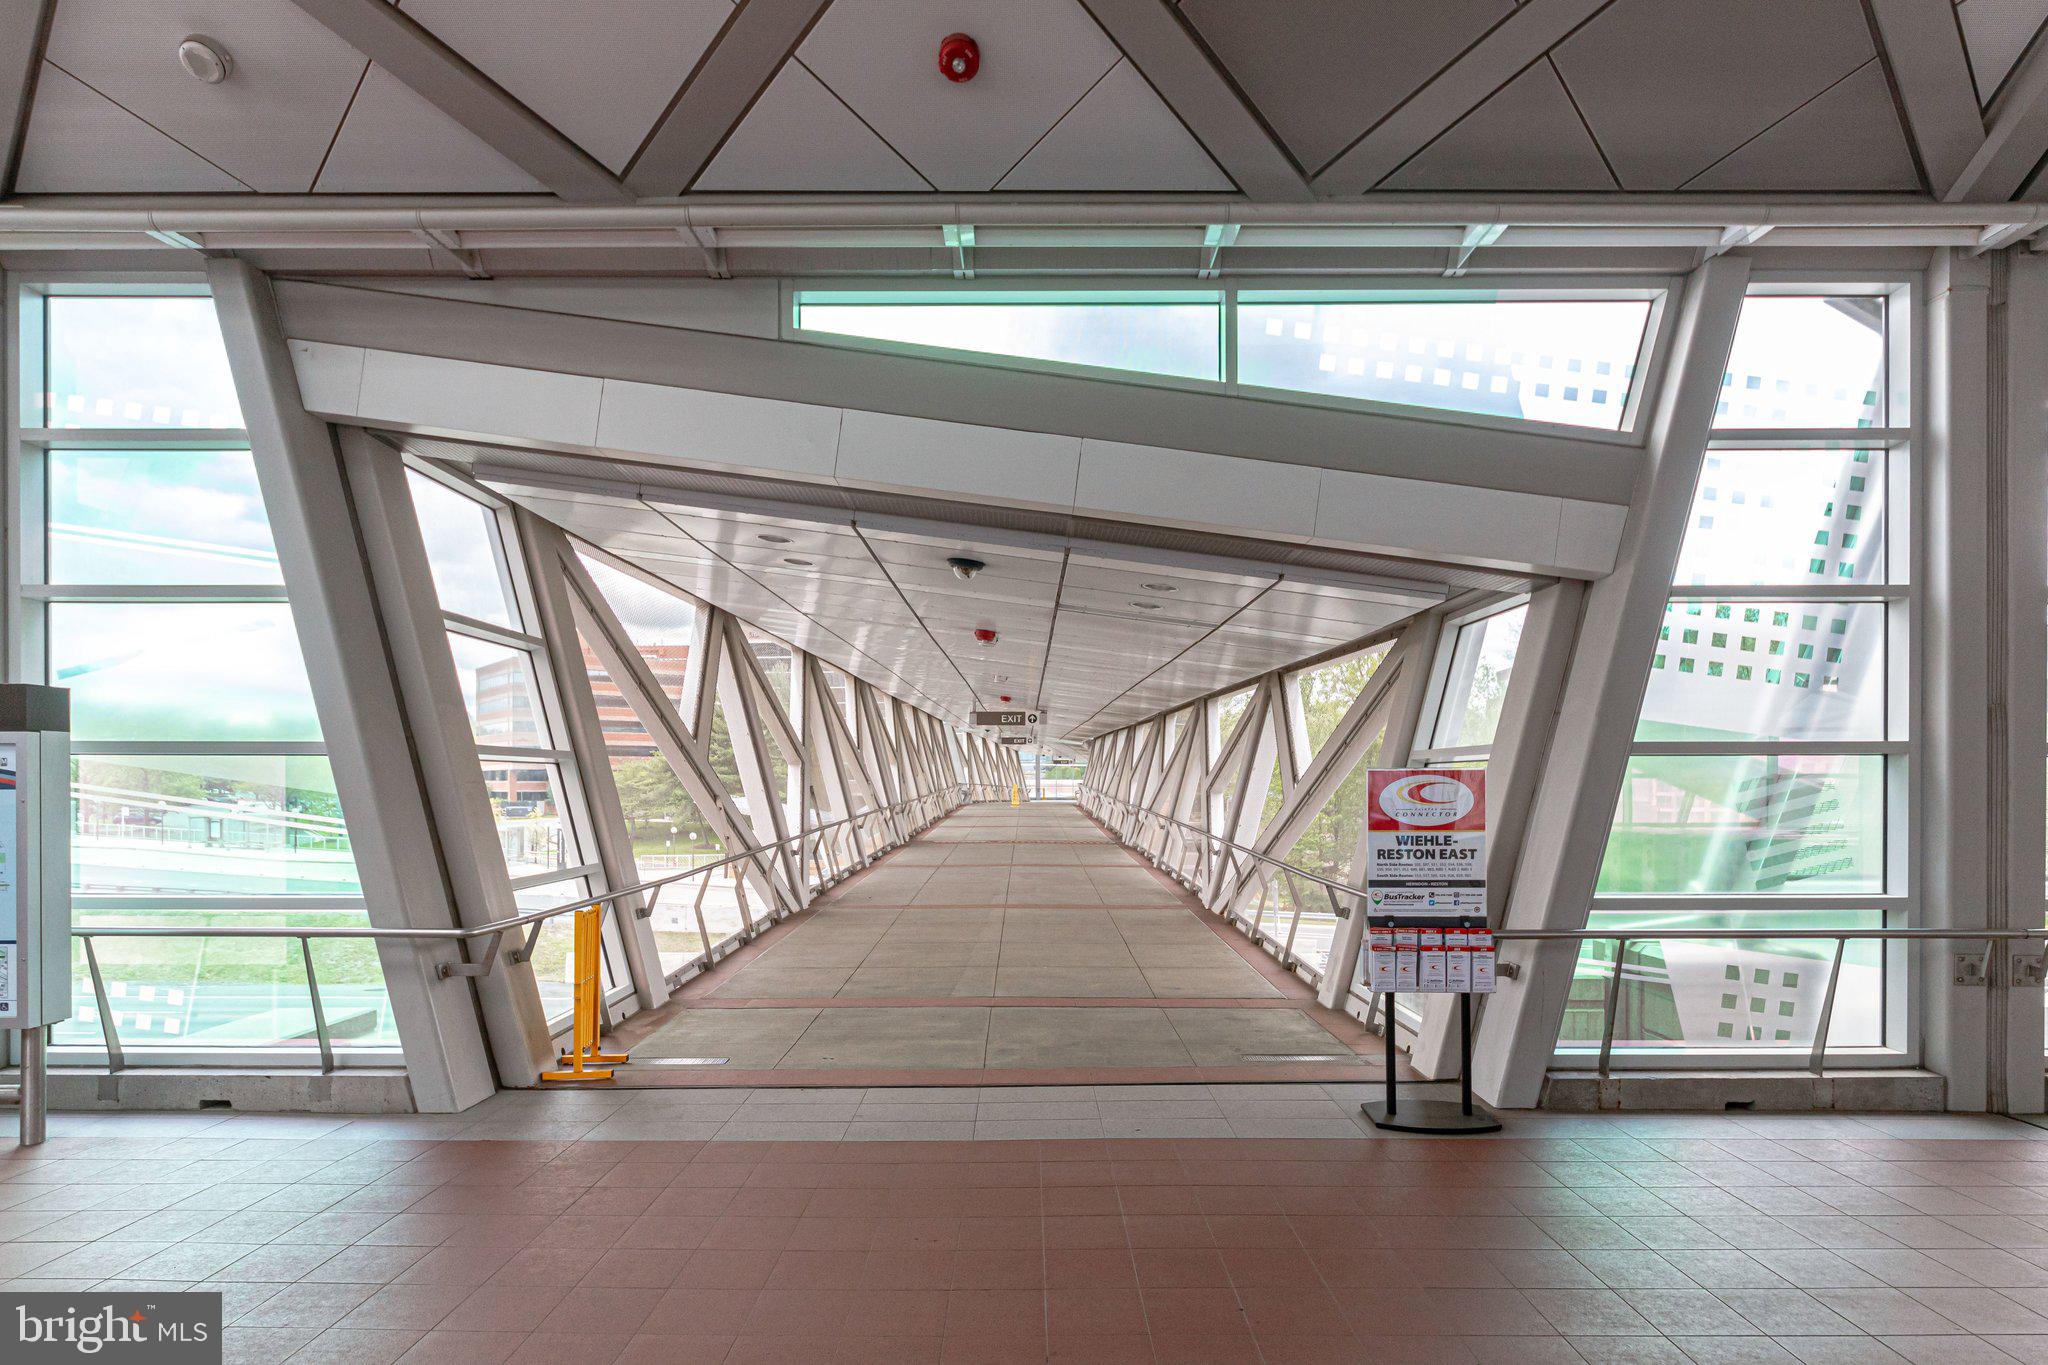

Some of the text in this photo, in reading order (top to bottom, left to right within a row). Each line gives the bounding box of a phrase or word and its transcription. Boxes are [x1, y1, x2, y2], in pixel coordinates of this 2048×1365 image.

[1001, 714, 1022, 723] EXIT
[1395, 835, 1458, 846] WIEHLE-
[1377, 848, 1478, 860] RESTON EAST
